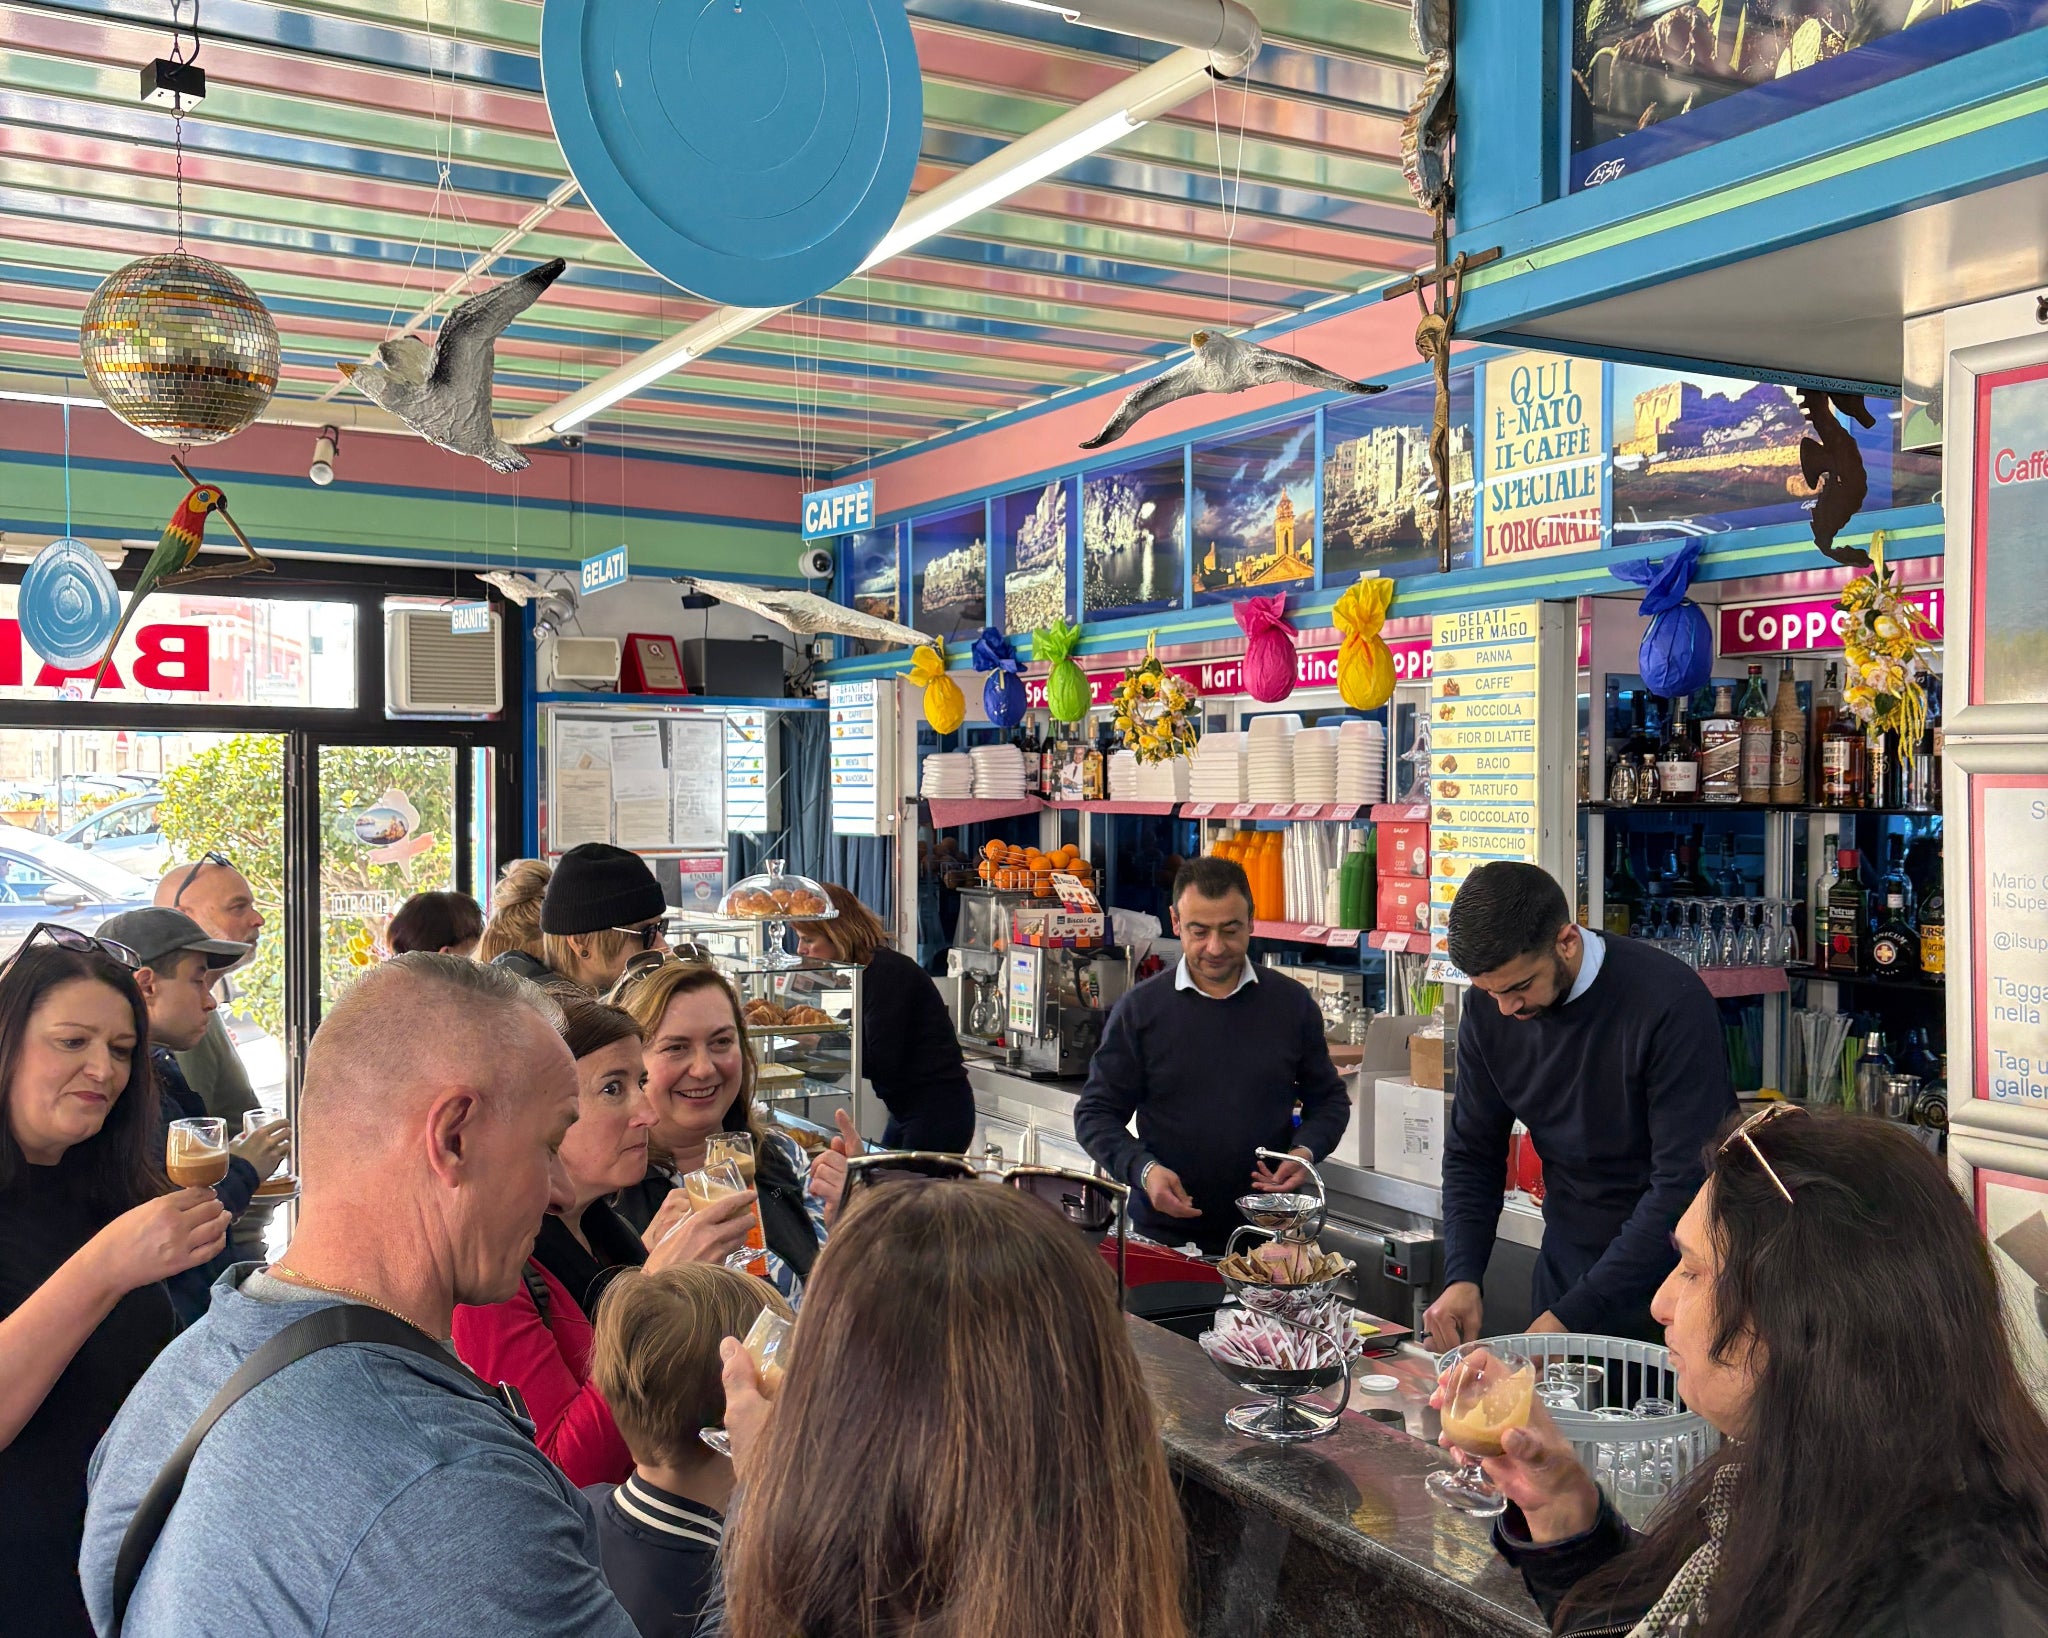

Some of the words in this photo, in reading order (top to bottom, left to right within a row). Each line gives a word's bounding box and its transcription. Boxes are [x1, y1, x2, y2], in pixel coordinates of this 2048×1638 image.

[1510, 358, 1574, 406] QUI
[1492, 464, 1596, 513] SPECIALE
[805, 483, 869, 533] CAFFÈ
[582, 551, 624, 589] GELATI
[452, 607, 488, 629] GRANITE
[1459, 609, 1506, 627] GELATI
[1441, 626, 1484, 643] SUPER
[1490, 621, 1527, 639] MAGO
[1476, 649, 1513, 664] PANNA
[1475, 676, 1513, 690] CAFFE'
[1466, 704, 1521, 717] NOCCIOLA
[1457, 731, 1481, 744] FIOR
[1484, 730, 1495, 743] DI
[1499, 730, 1531, 743] LATTE
[1477, 757, 1510, 769] BACIO
[1469, 784, 1518, 795] TARTUFO
[1460, 811, 1529, 823] CIOCCOLATO
[1462, 836, 1526, 849] PISTACCHIO
[1993, 872, 2037, 890] Mario
[1993, 893, 2000, 907] il
[2006, 893, 2048, 913] Supe
[1995, 1004, 2040, 1024] nella
[1994, 1050, 2030, 1077] Tag
